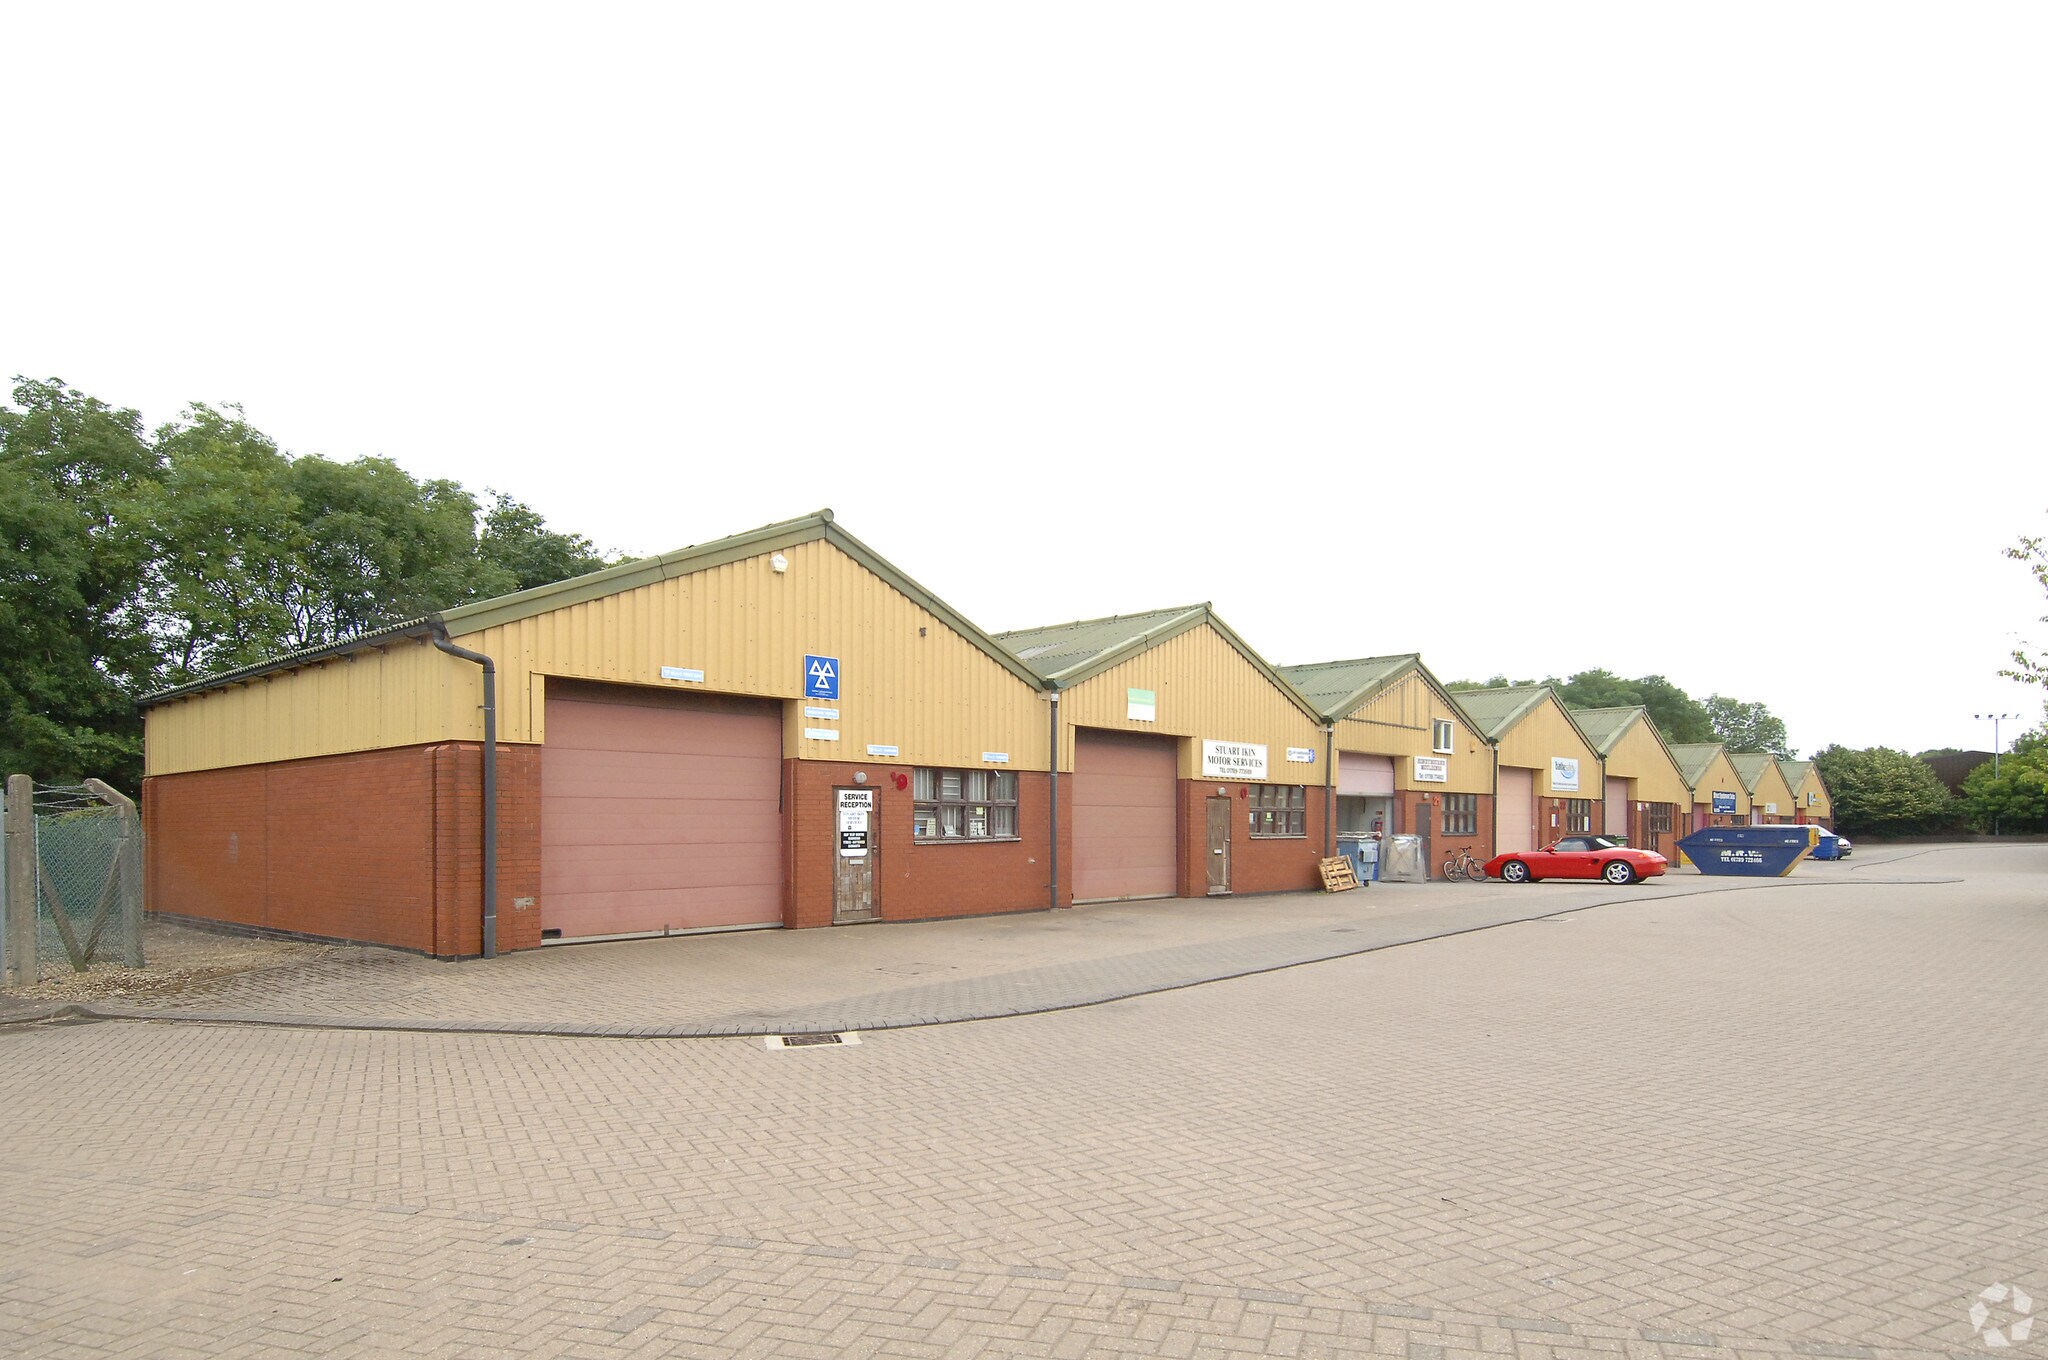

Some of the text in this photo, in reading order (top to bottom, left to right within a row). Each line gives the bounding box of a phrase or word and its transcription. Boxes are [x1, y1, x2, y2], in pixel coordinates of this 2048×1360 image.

[1215, 744, 1256, 757] STUART IKIN
[1207, 755, 1263, 768] MOTOR SERVICES
